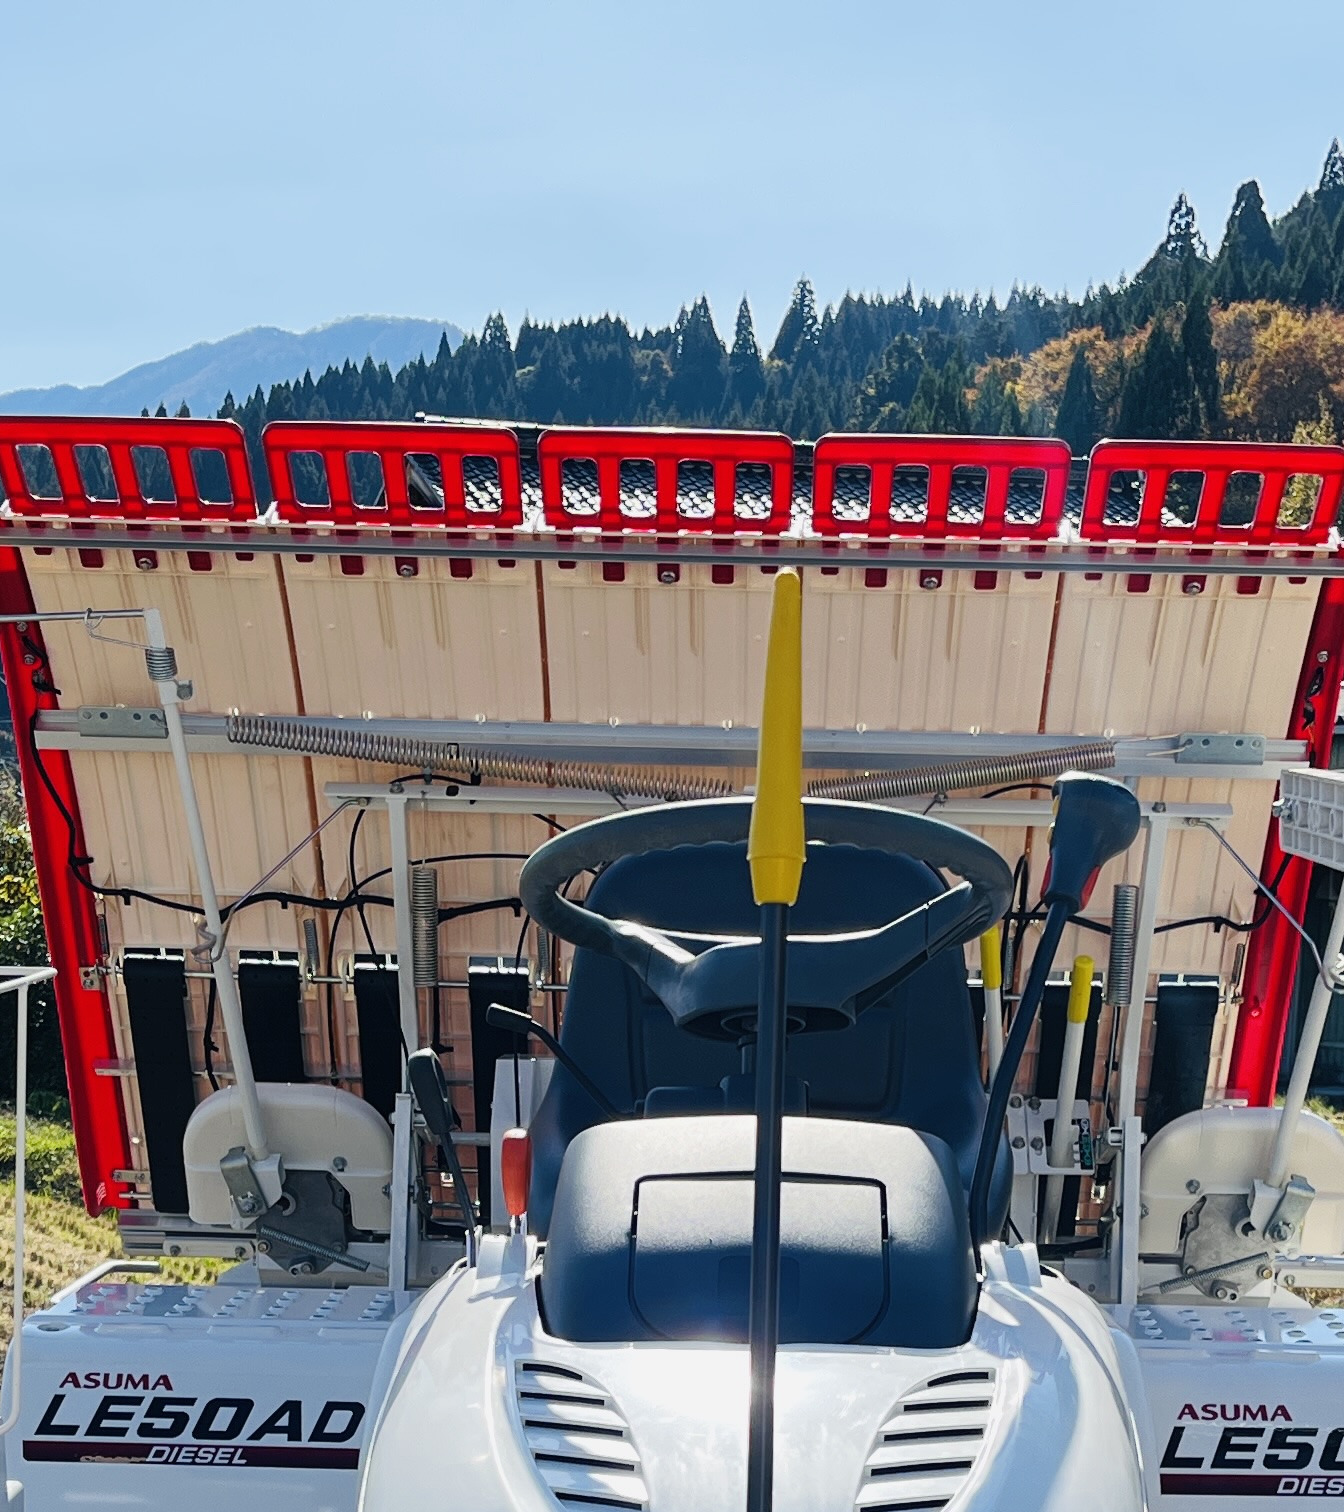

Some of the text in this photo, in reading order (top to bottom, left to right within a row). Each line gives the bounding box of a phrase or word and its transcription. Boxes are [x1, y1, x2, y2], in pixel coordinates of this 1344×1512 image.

[59, 1372, 174, 1391] ASUMA
[34, 1394, 366, 1443] LE50AD
[1177, 1403, 1293, 1422] ASUMA
[145, 1446, 248, 1465] DIESEL
